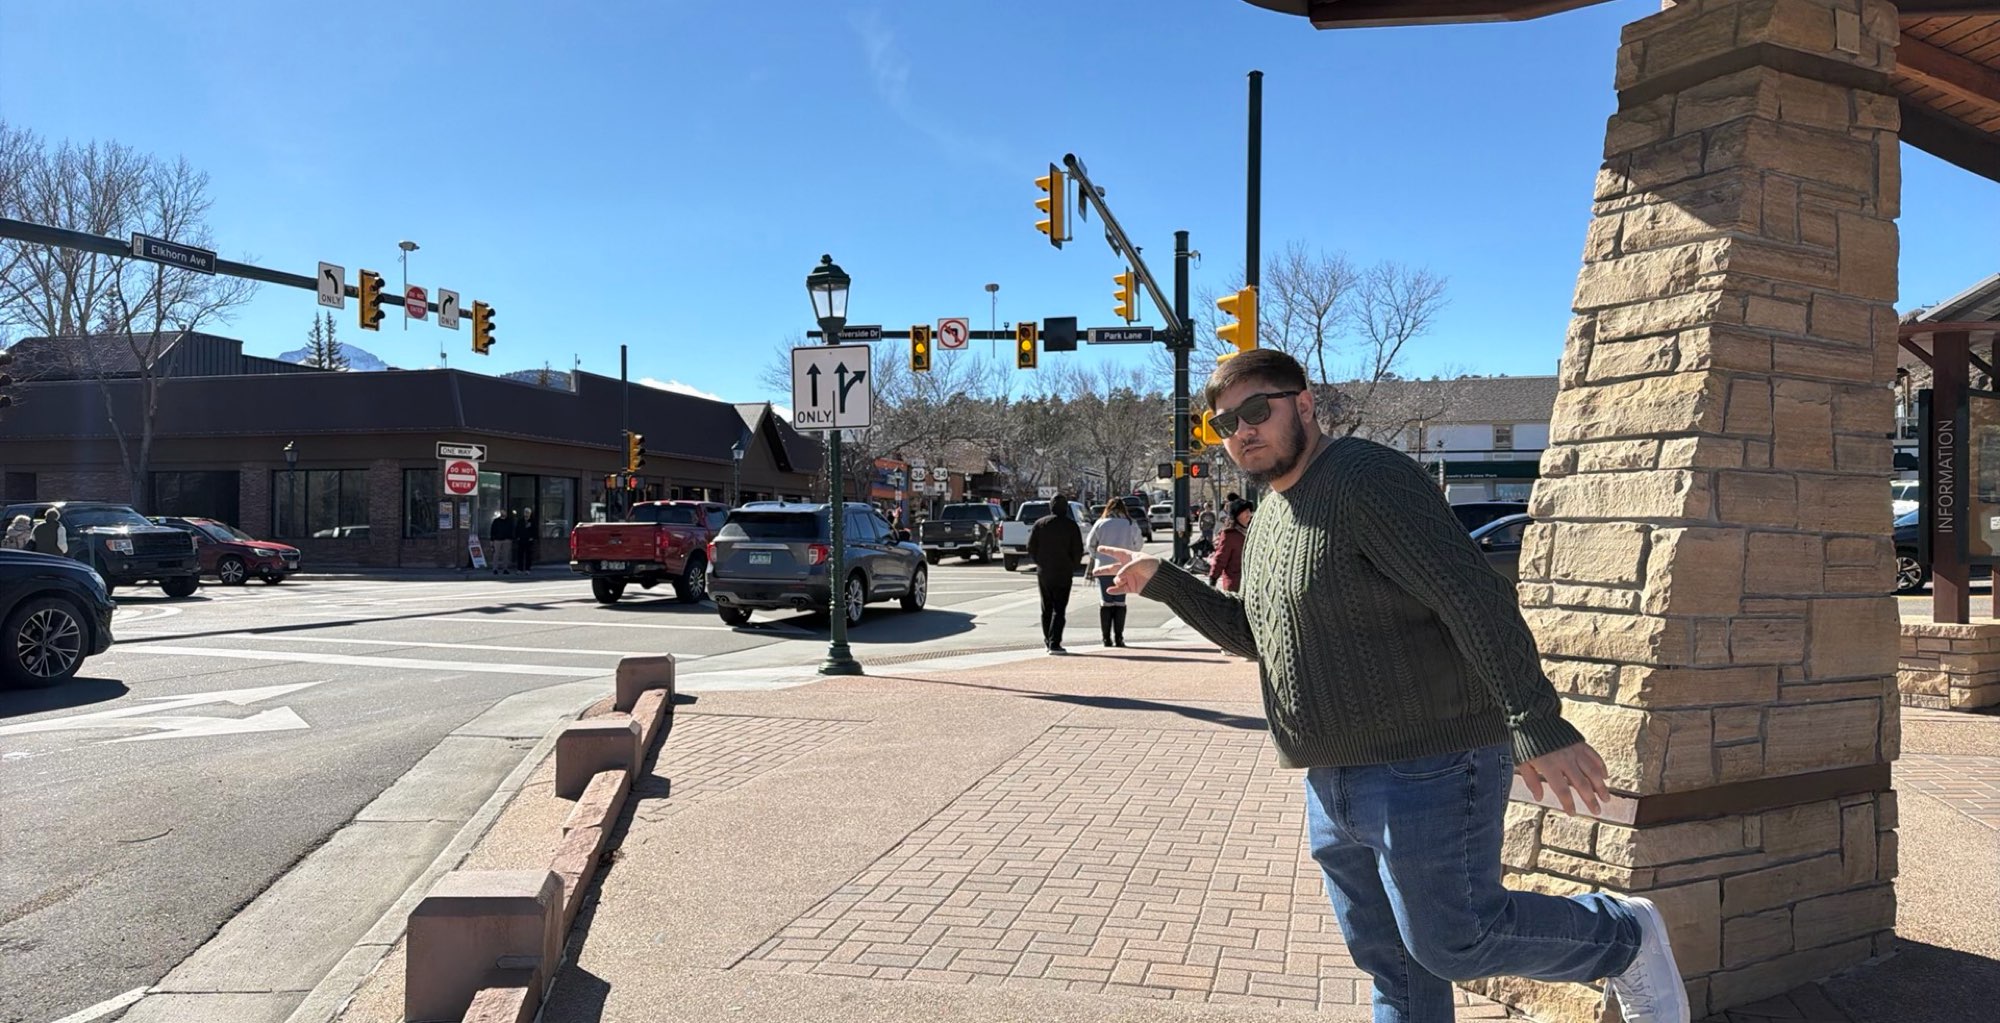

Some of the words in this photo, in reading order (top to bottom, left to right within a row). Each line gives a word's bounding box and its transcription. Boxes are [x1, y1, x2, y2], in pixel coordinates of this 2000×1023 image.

[151, 244, 187, 262] Elkhorn
[190, 254, 207, 267] Ave
[321, 293, 340, 305] ONLY
[441, 316, 457, 326] ONLY
[870, 329, 879, 337] Dr
[1104, 332, 1122, 340] Park
[1123, 332, 1142, 340] Lane
[797, 410, 832, 423] ONLY
[912, 470, 924, 479] 36
[934, 470, 947, 479] 34
[1938, 420, 1954, 533] INFORMATION
